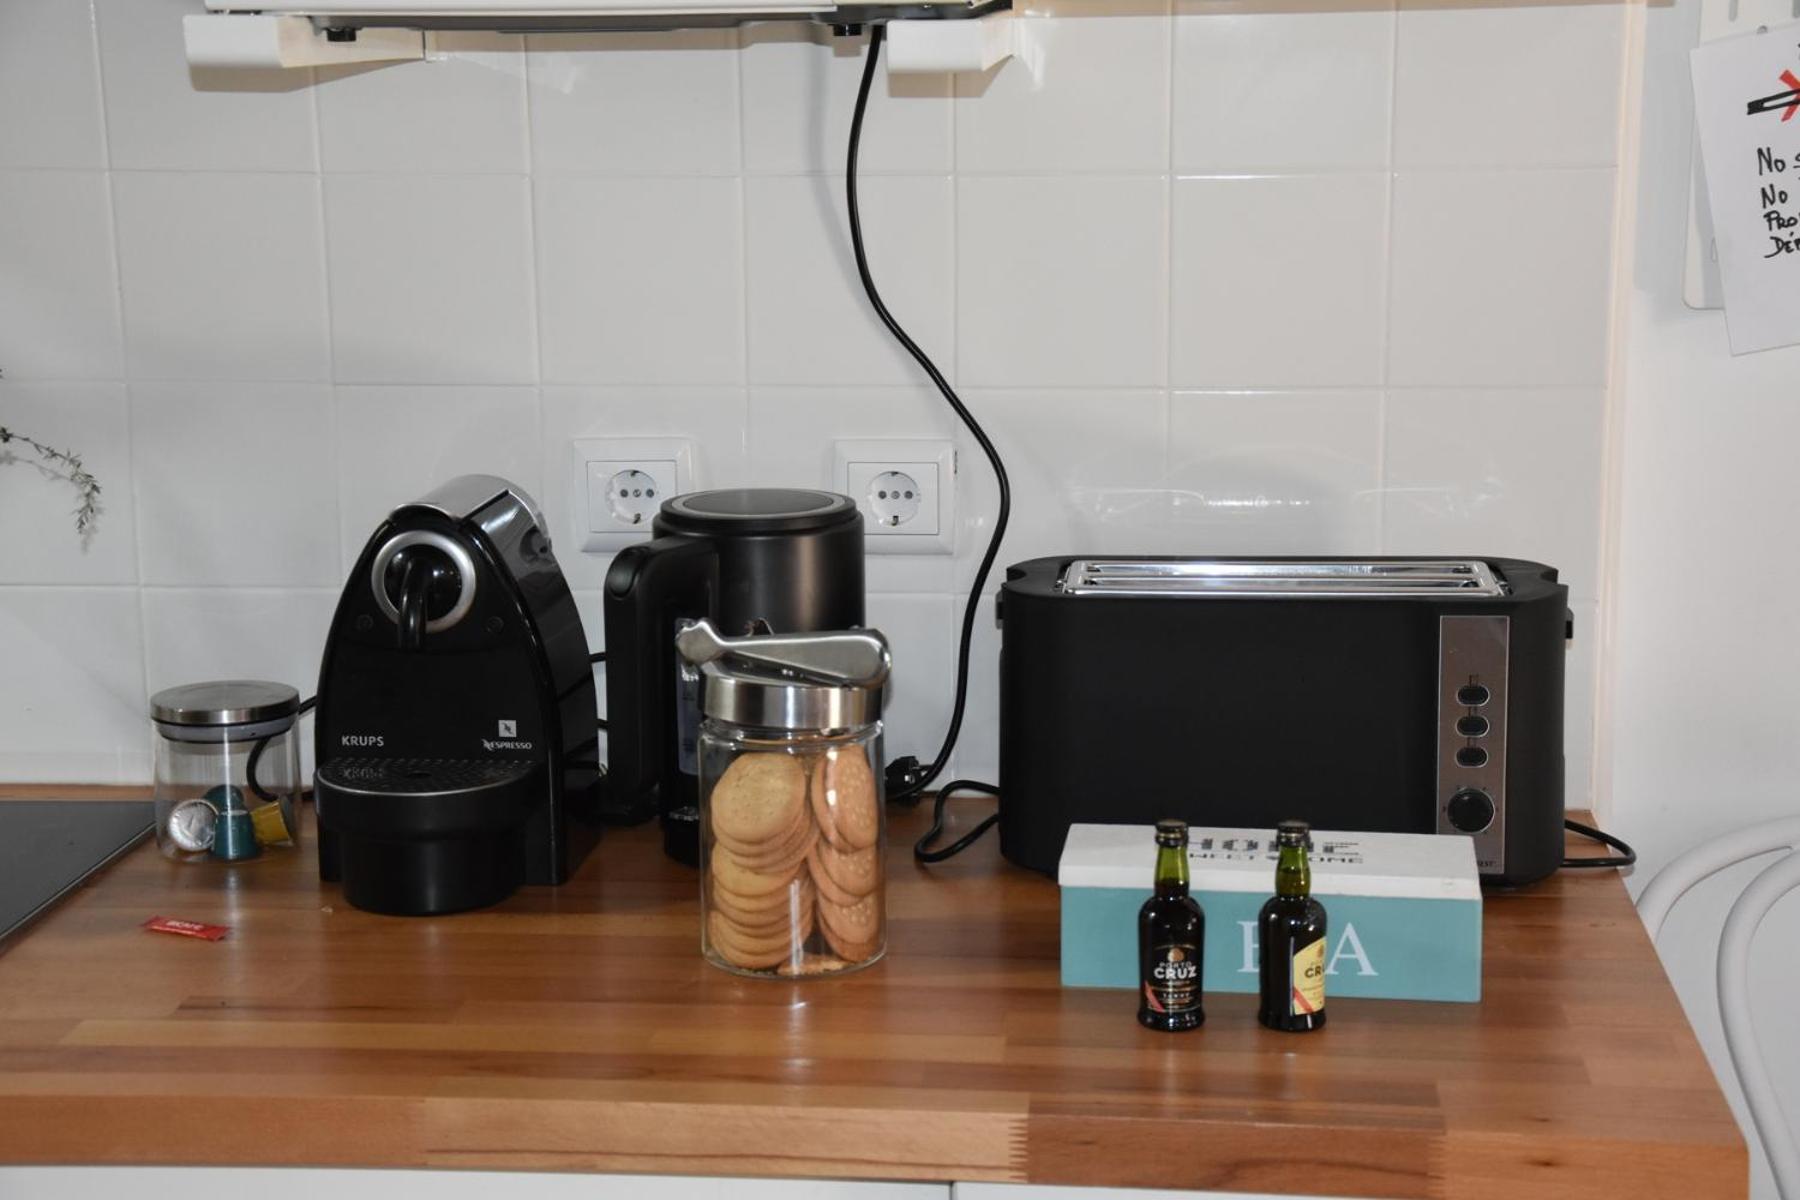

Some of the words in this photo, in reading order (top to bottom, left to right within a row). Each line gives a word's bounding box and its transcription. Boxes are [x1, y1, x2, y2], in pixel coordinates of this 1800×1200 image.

[1757, 146, 1786, 176] No
[1761, 183, 1788, 209] No
[341, 735, 385, 747] KRUPS
[481, 738, 533, 751] NESPRESSO
[1153, 966, 1197, 980] CRUZ
[1304, 965, 1326, 979] CR
